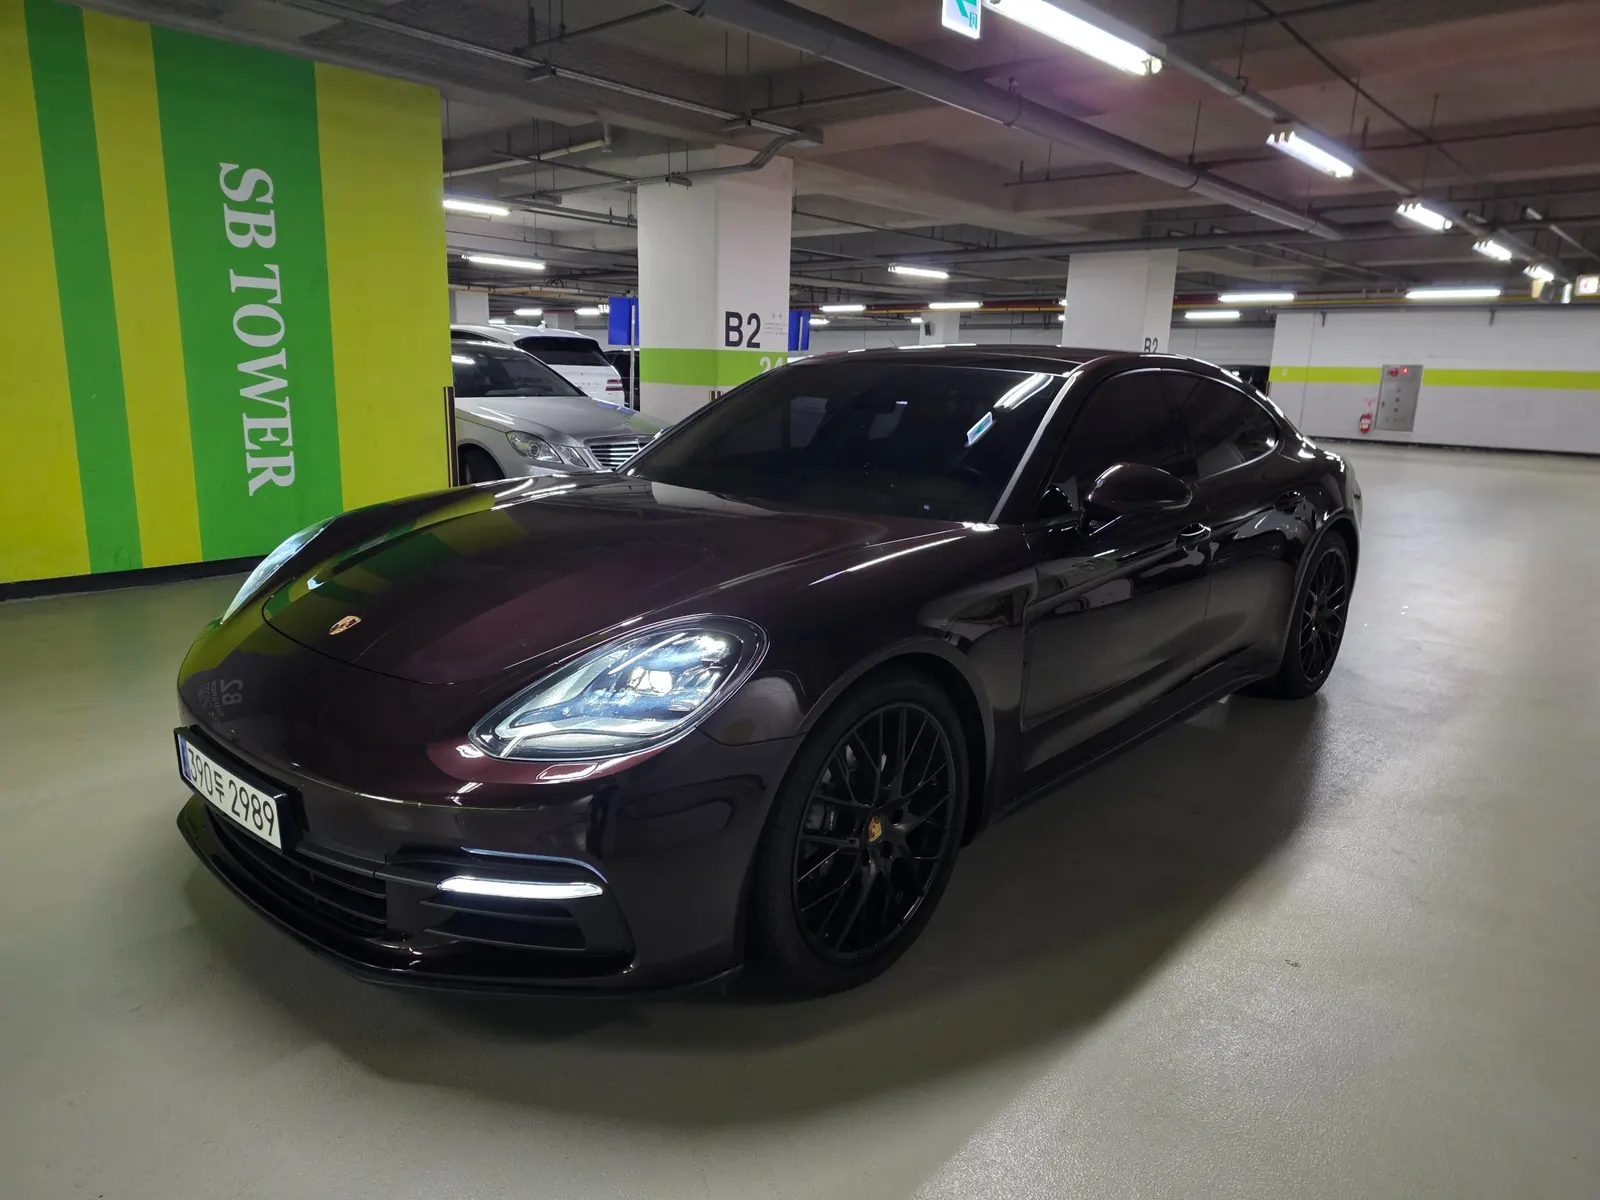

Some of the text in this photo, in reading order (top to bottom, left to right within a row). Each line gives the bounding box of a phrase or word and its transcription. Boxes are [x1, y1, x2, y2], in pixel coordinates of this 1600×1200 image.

[219, 162, 296, 497] SB TOWER
[725, 310, 761, 349] B2
[1143, 337, 1158, 353] B2
[228, 779, 275, 837] 2989
